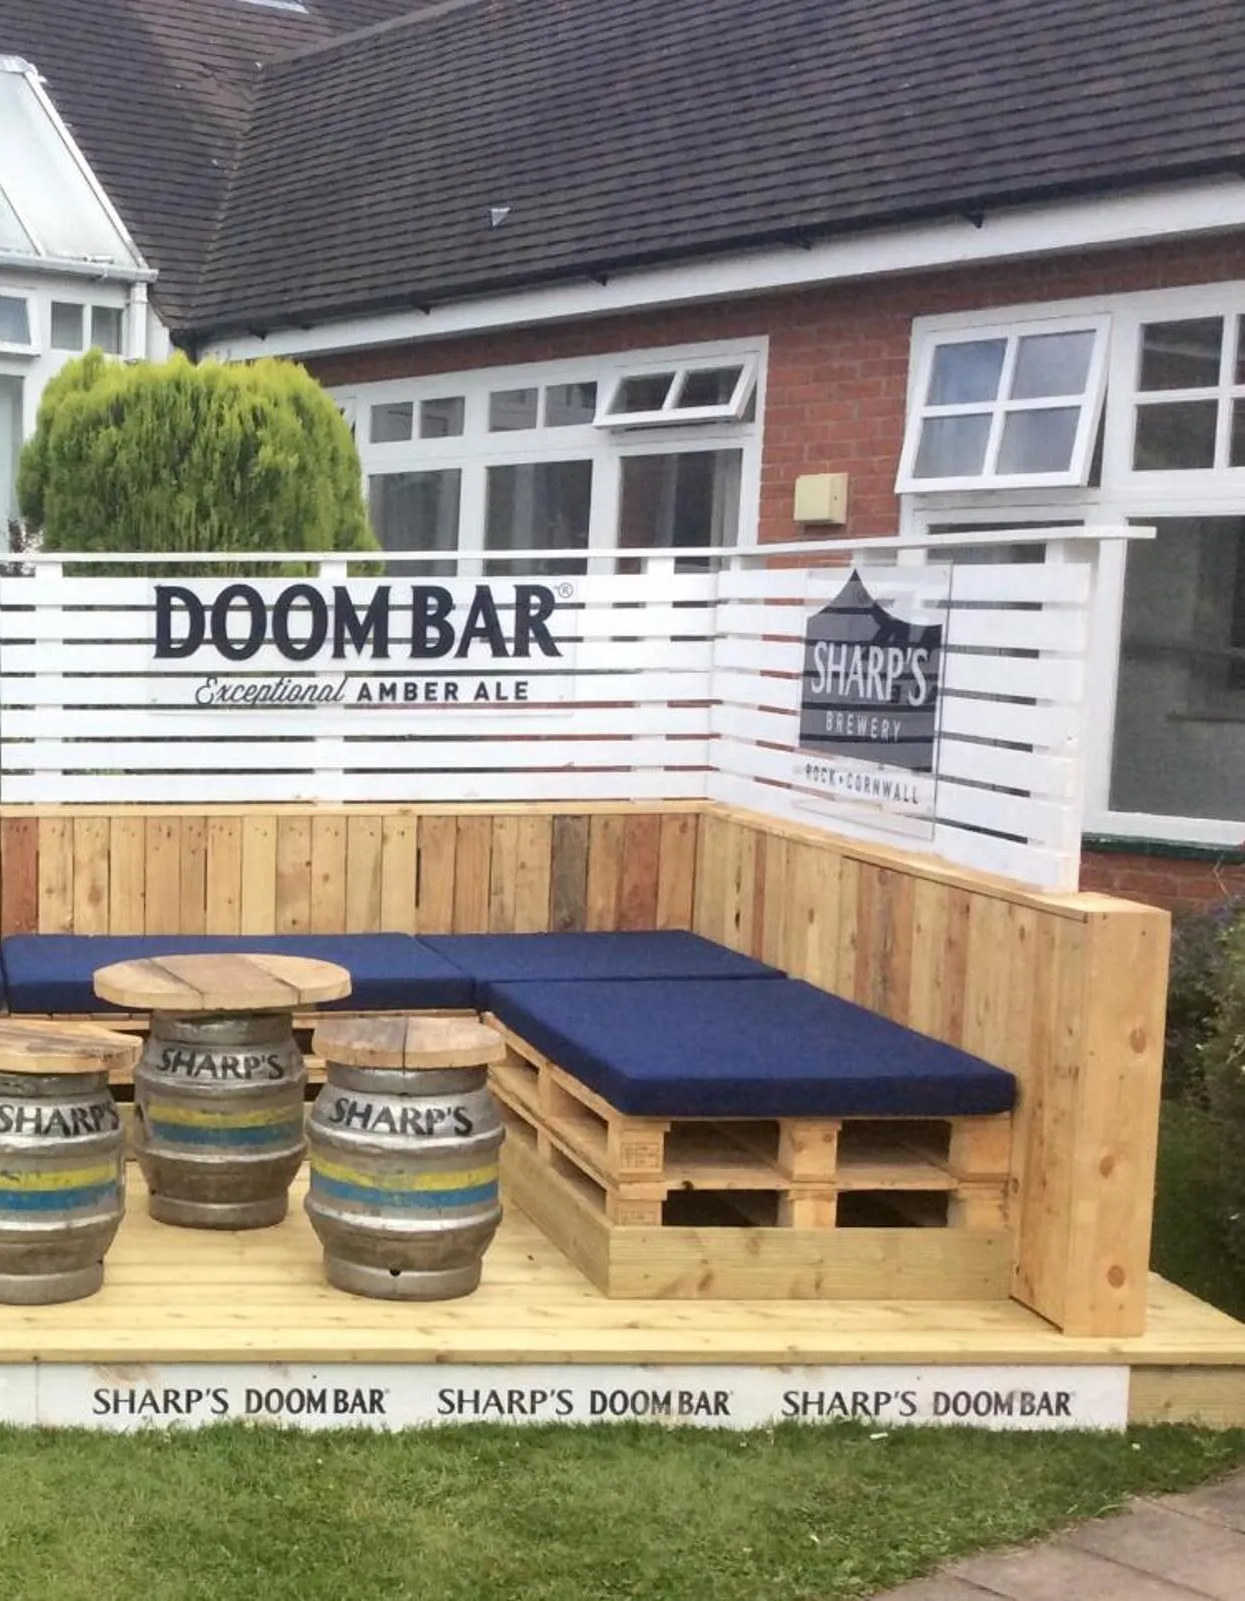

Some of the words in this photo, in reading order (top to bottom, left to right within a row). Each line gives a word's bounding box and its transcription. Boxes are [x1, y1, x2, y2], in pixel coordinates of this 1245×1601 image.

[153, 583, 392, 661] DOOM
[811, 640, 929, 707] SHARP'S
[194, 676, 351, 705] Exceptional
[357, 681, 459, 701] AMBER
[473, 681, 529, 701] ALE
[825, 710, 903, 743] BREWERY
[805, 763, 836, 786] ROCK
[846, 772, 919, 805] CORNWALL
[156, 1047, 285, 1080] SHARP'S
[329, 1097, 474, 1137] SHARP'S
[92, 1387, 229, 1415] SHARP'S
[244, 1388, 328, 1414] DOOM
[437, 1388, 574, 1416] SHARP'S
[589, 1389, 672, 1416] DOOM
[782, 1390, 918, 1417] SHARP'S
[932, 1390, 1015, 1417] DOOM
